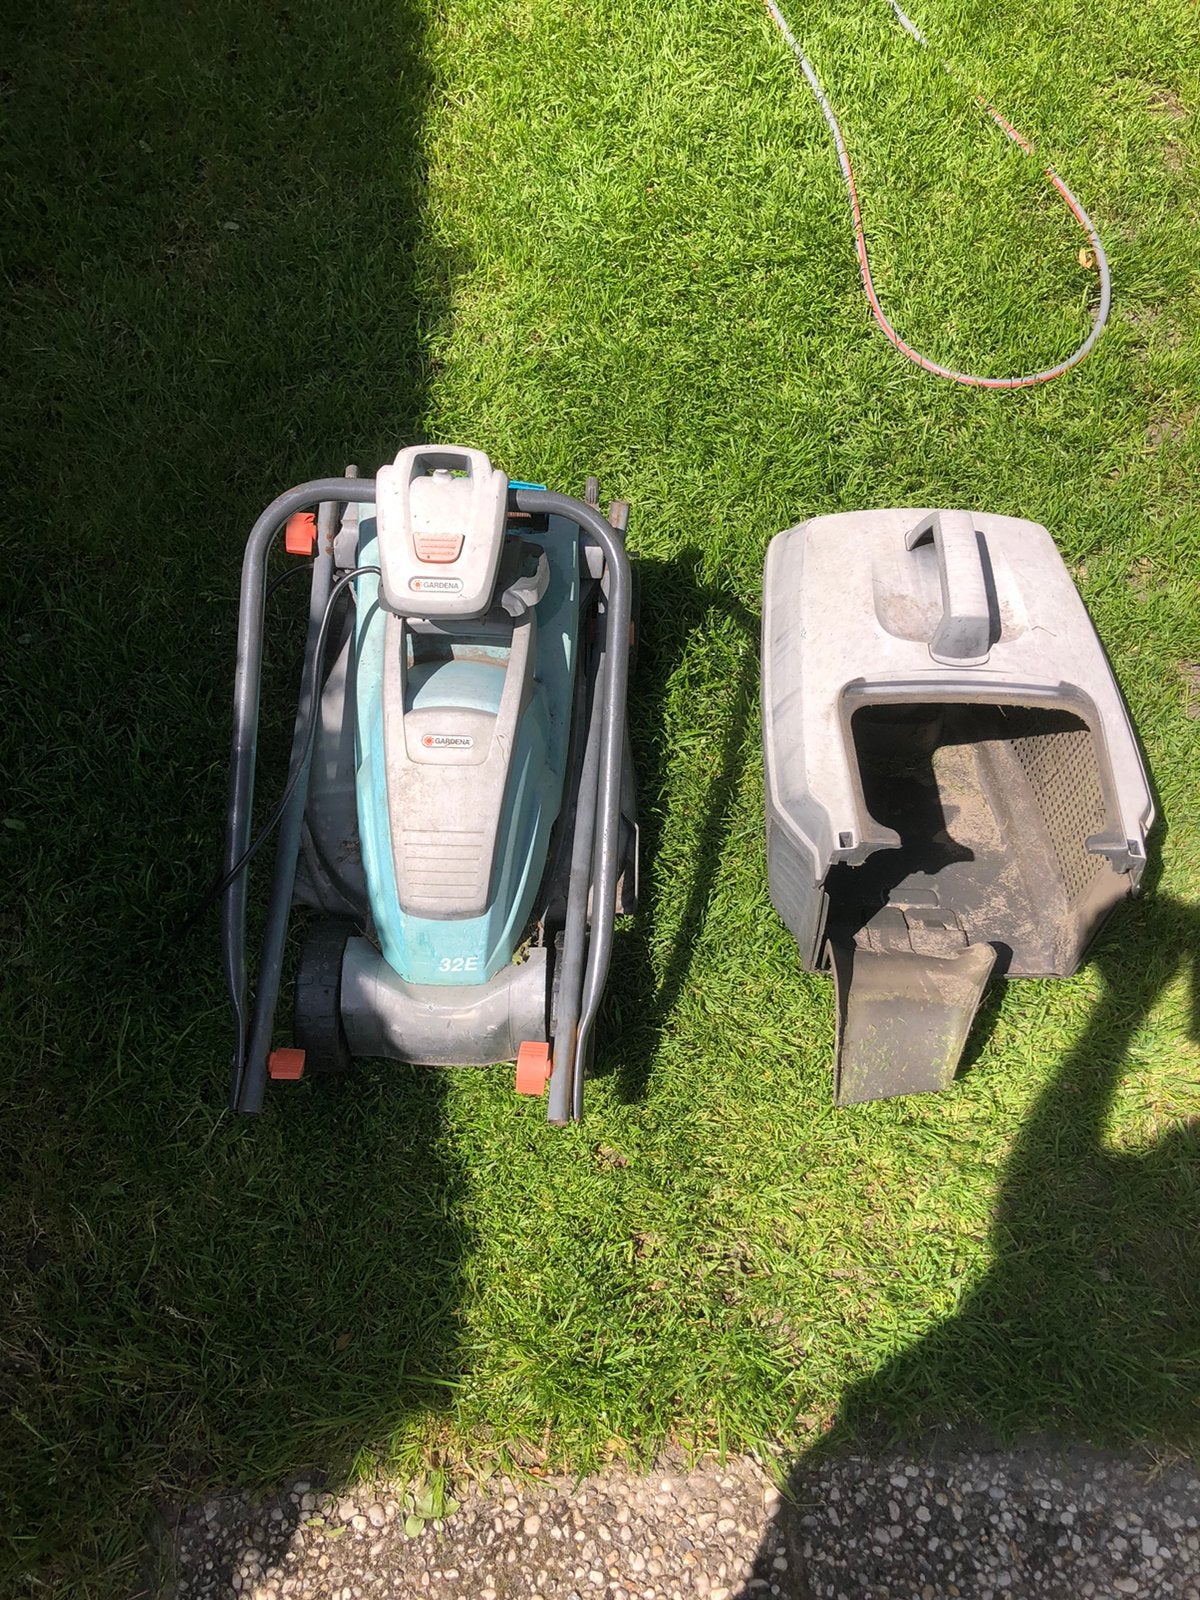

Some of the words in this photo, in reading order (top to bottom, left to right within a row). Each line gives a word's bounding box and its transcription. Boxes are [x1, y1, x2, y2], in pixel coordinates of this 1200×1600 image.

[423, 581, 459, 589] GARDENA
[434, 737, 470, 745] GARDENA
[439, 956, 479, 971] 32E
